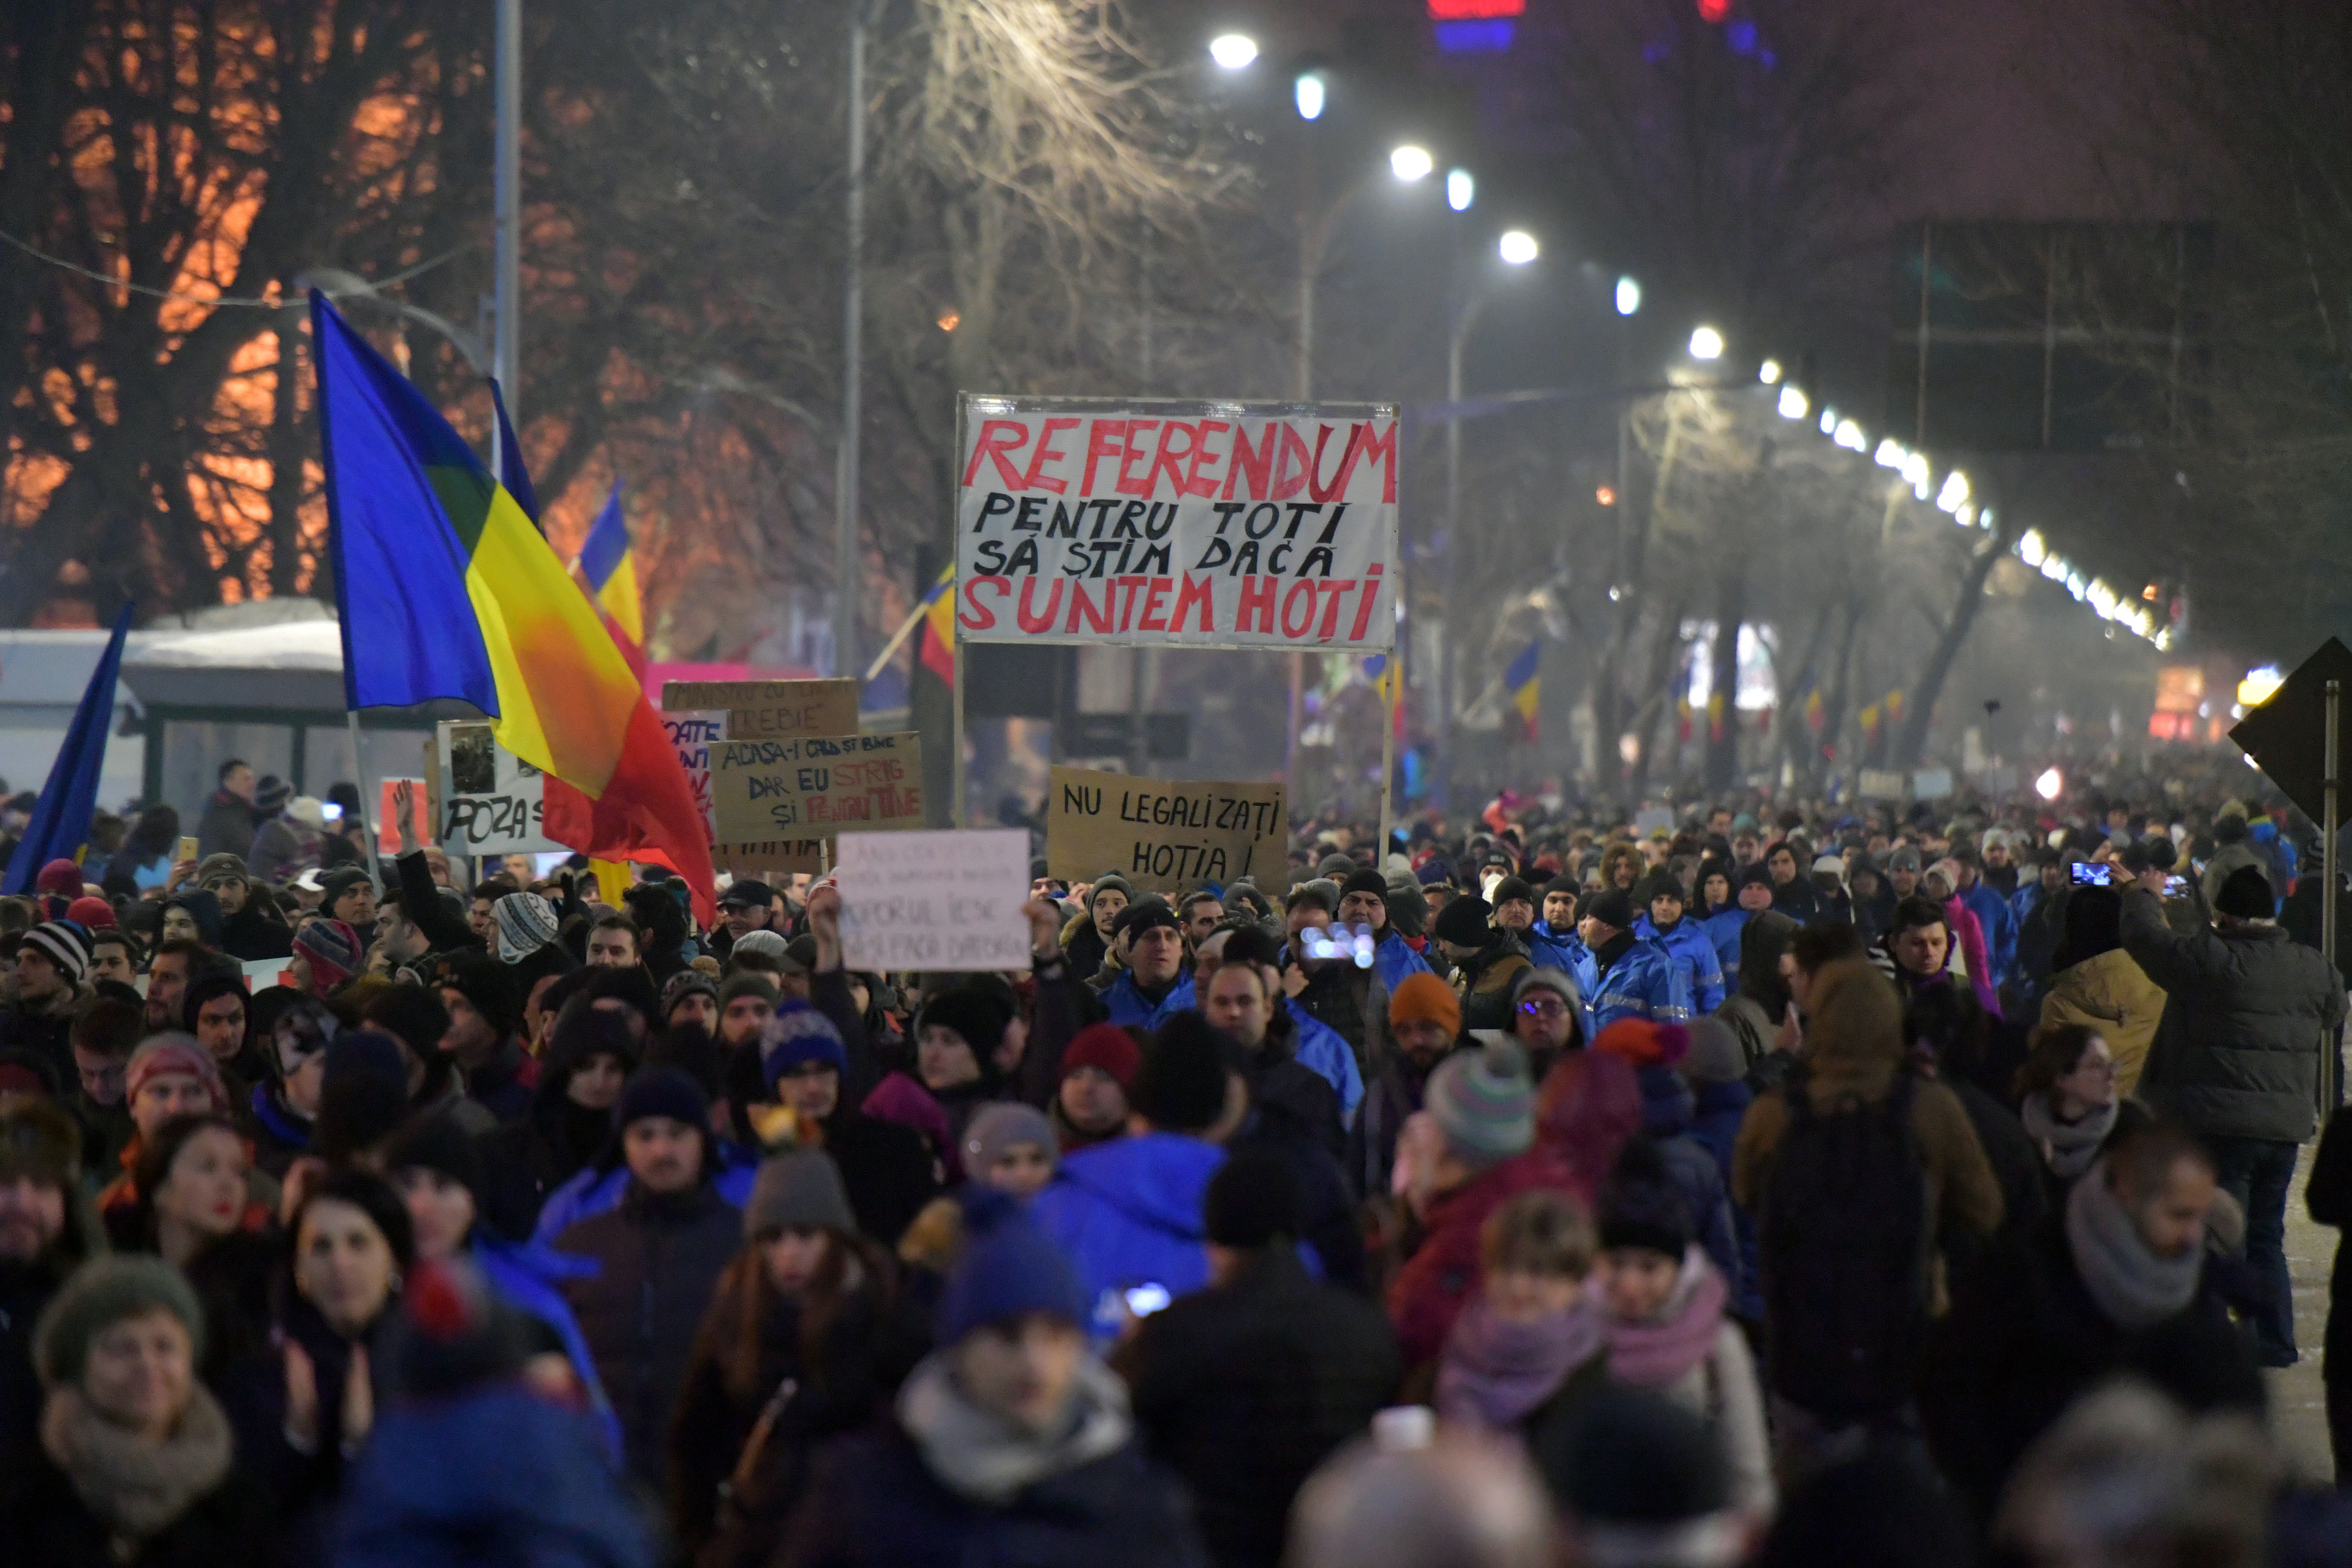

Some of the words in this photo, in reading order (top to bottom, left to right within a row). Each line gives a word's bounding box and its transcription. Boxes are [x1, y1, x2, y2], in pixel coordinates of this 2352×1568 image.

[962, 418, 1396, 504] REFERENDUM
[973, 492, 1179, 540] PENTRU
[958, 570, 1214, 634] SUNTEM
[749, 776, 790, 800] DAR
[797, 768, 829, 792] EU
[833, 759, 904, 786] STRIG
[1064, 784, 1101, 815] NU
